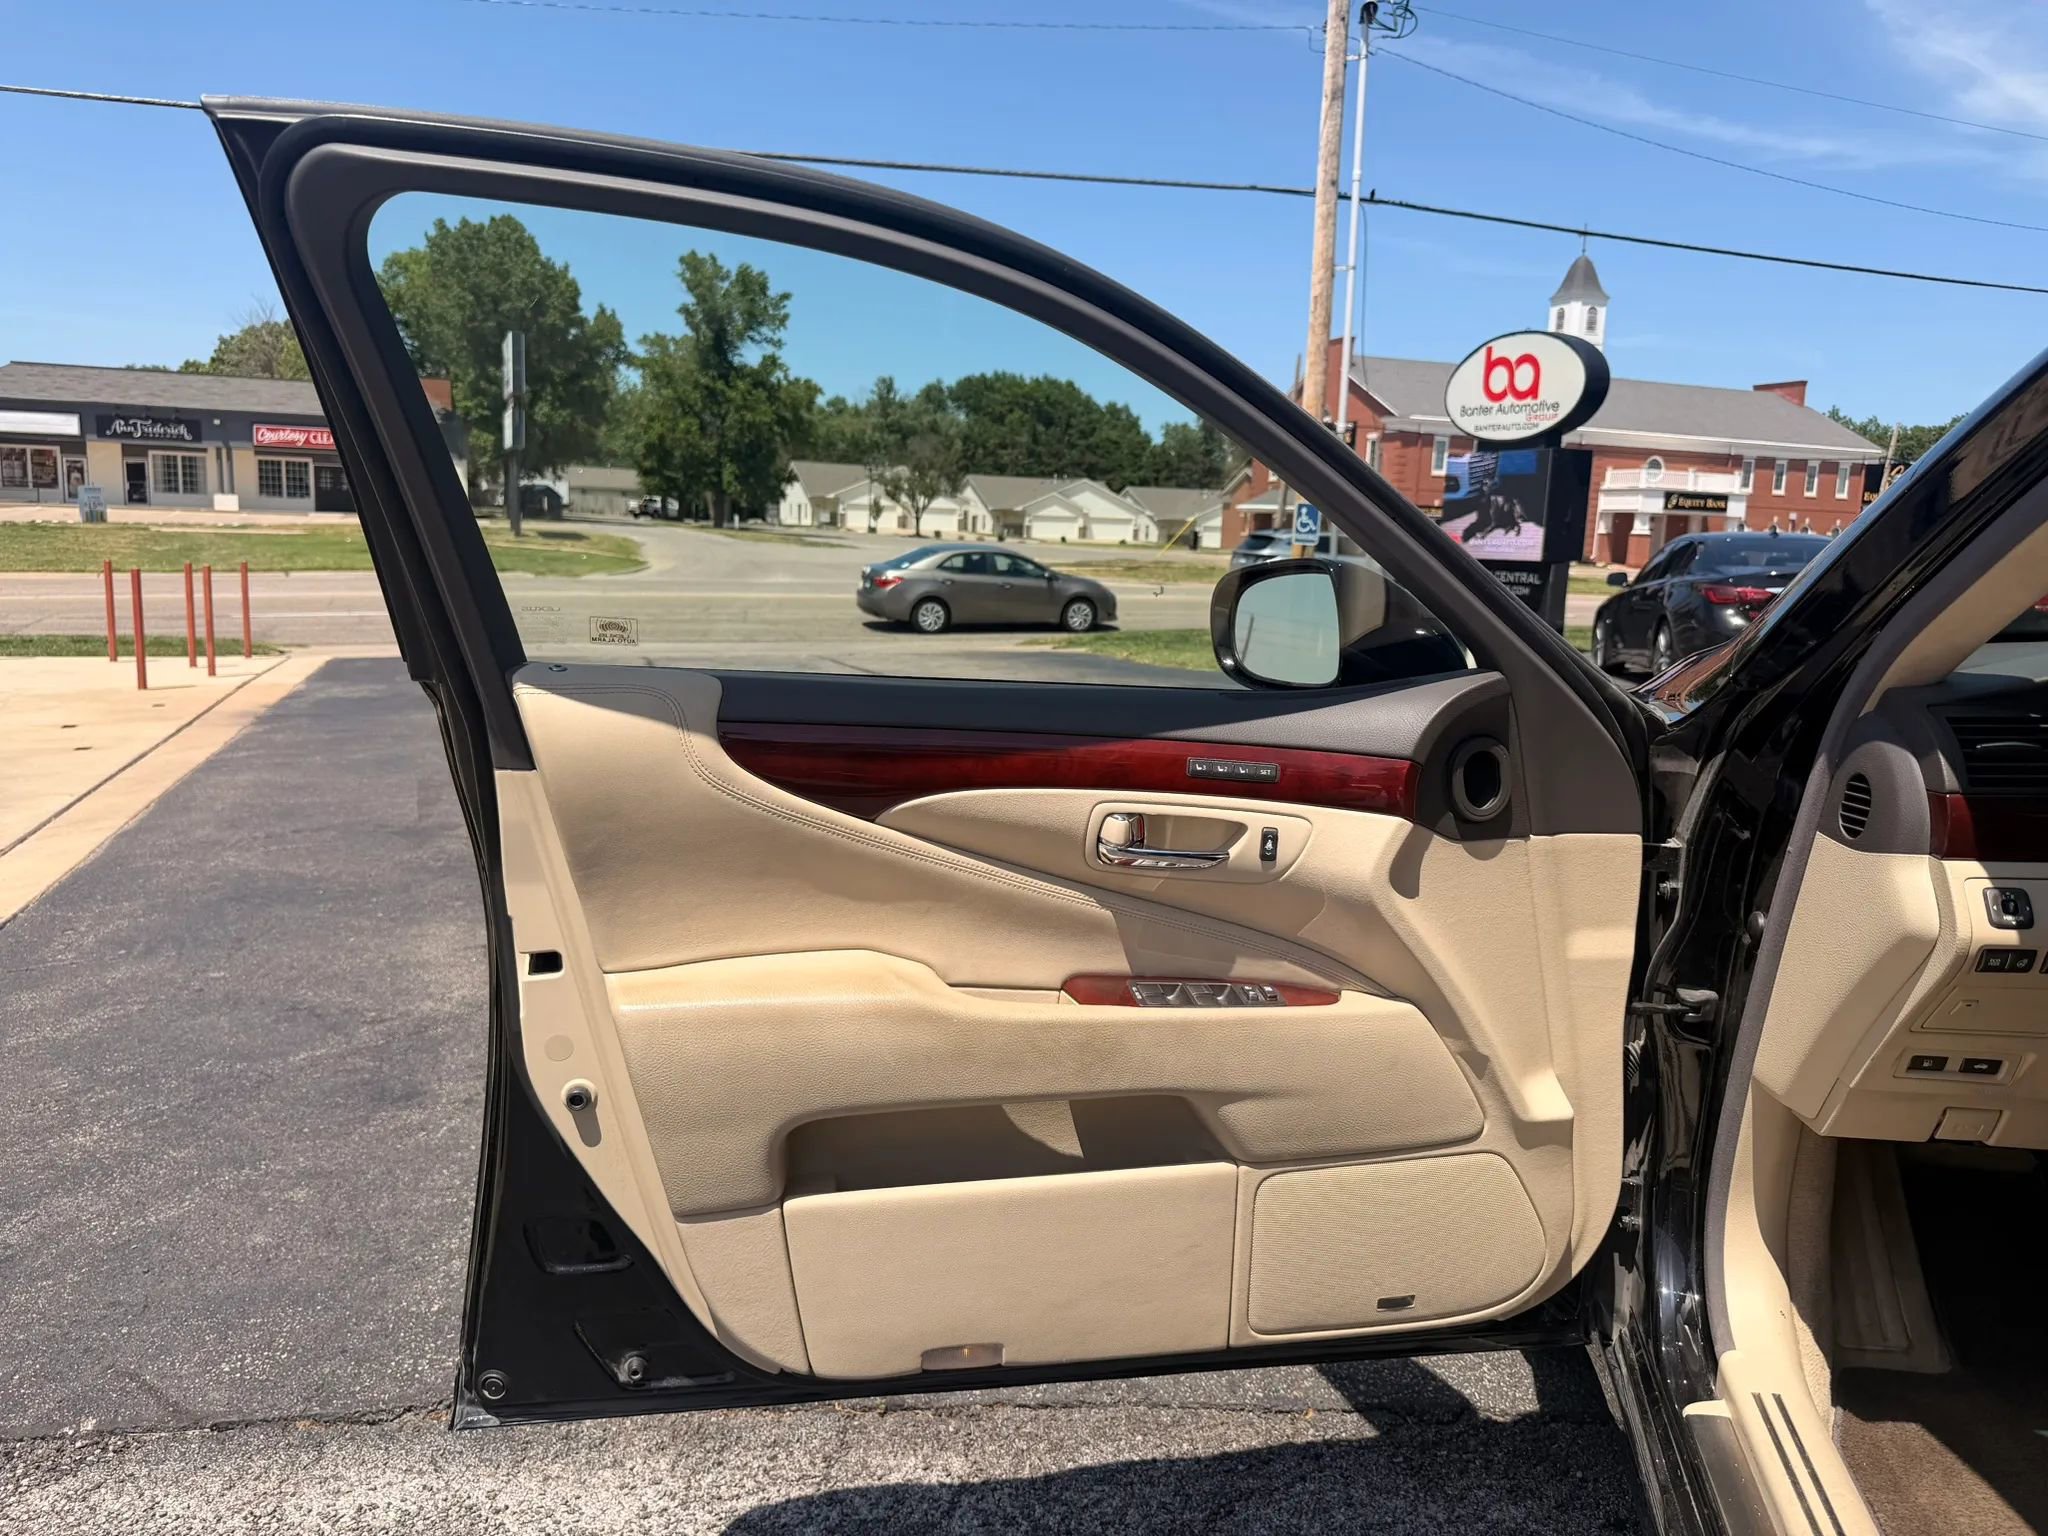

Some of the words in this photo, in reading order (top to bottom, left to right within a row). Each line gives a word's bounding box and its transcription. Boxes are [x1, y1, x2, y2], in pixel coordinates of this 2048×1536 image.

[1483, 346, 1540, 403] ba
[1460, 405, 1493, 418] Banter
[1496, 400, 1560, 416] Automotive
[1525, 413, 1558, 422] GROUP
[257, 428, 308, 447] Courtesy
